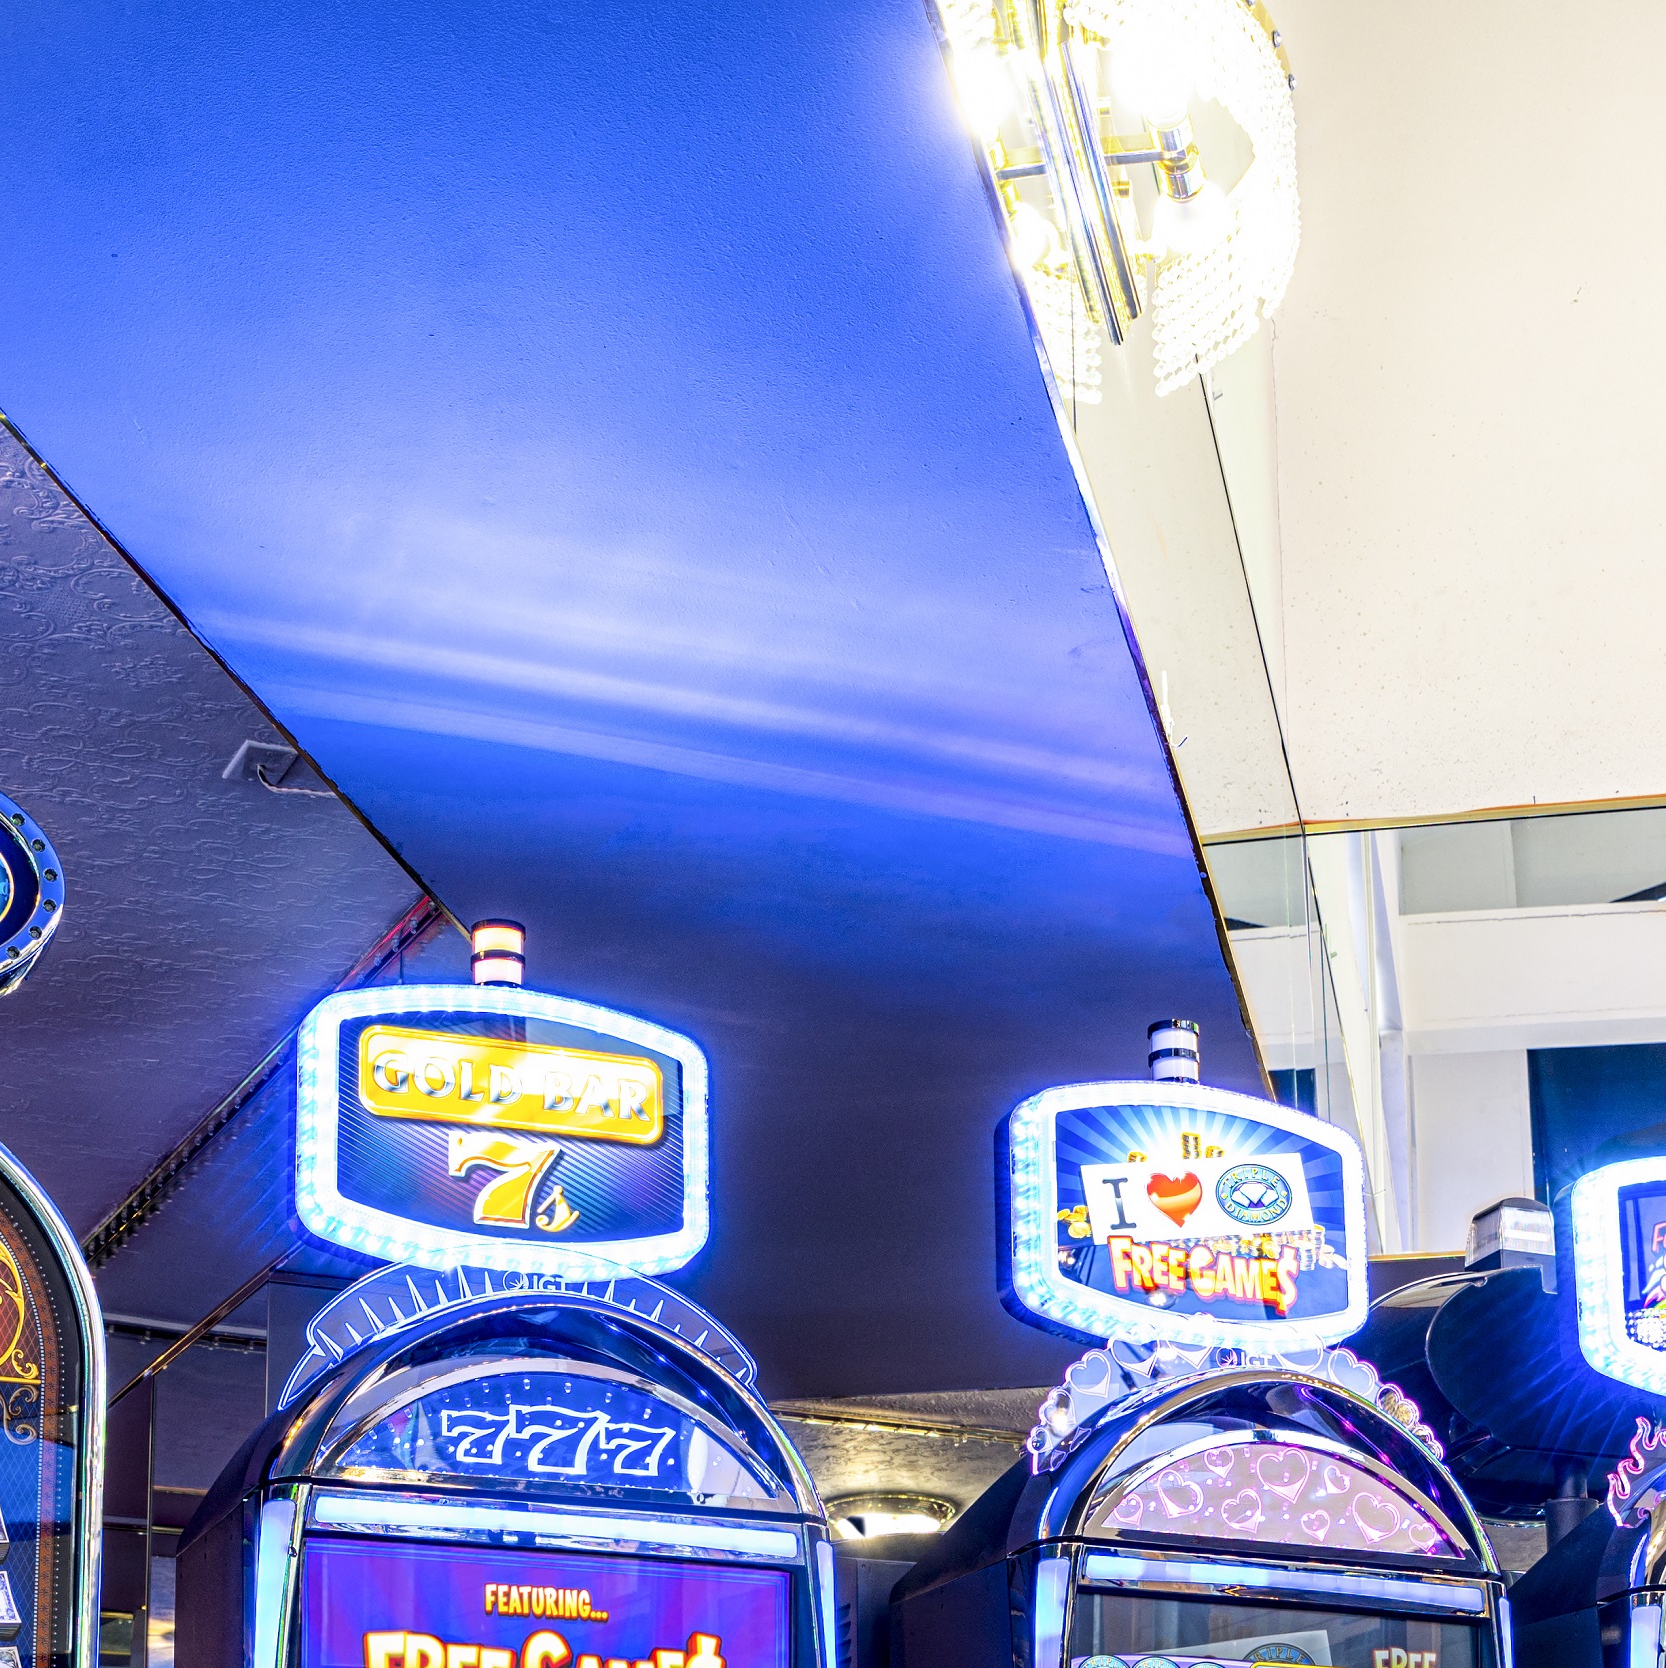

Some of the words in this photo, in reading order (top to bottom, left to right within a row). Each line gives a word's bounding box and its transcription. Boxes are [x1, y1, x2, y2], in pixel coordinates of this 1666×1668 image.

[372, 1050, 524, 1106] GOLD
[542, 1071, 651, 1123] BAR
[1223, 1164, 1281, 1187] TRIPLE
[1102, 1177, 1137, 1230] I
[1223, 1197, 1287, 1225] DIAMOND
[1108, 1236, 1187, 1295] FREE
